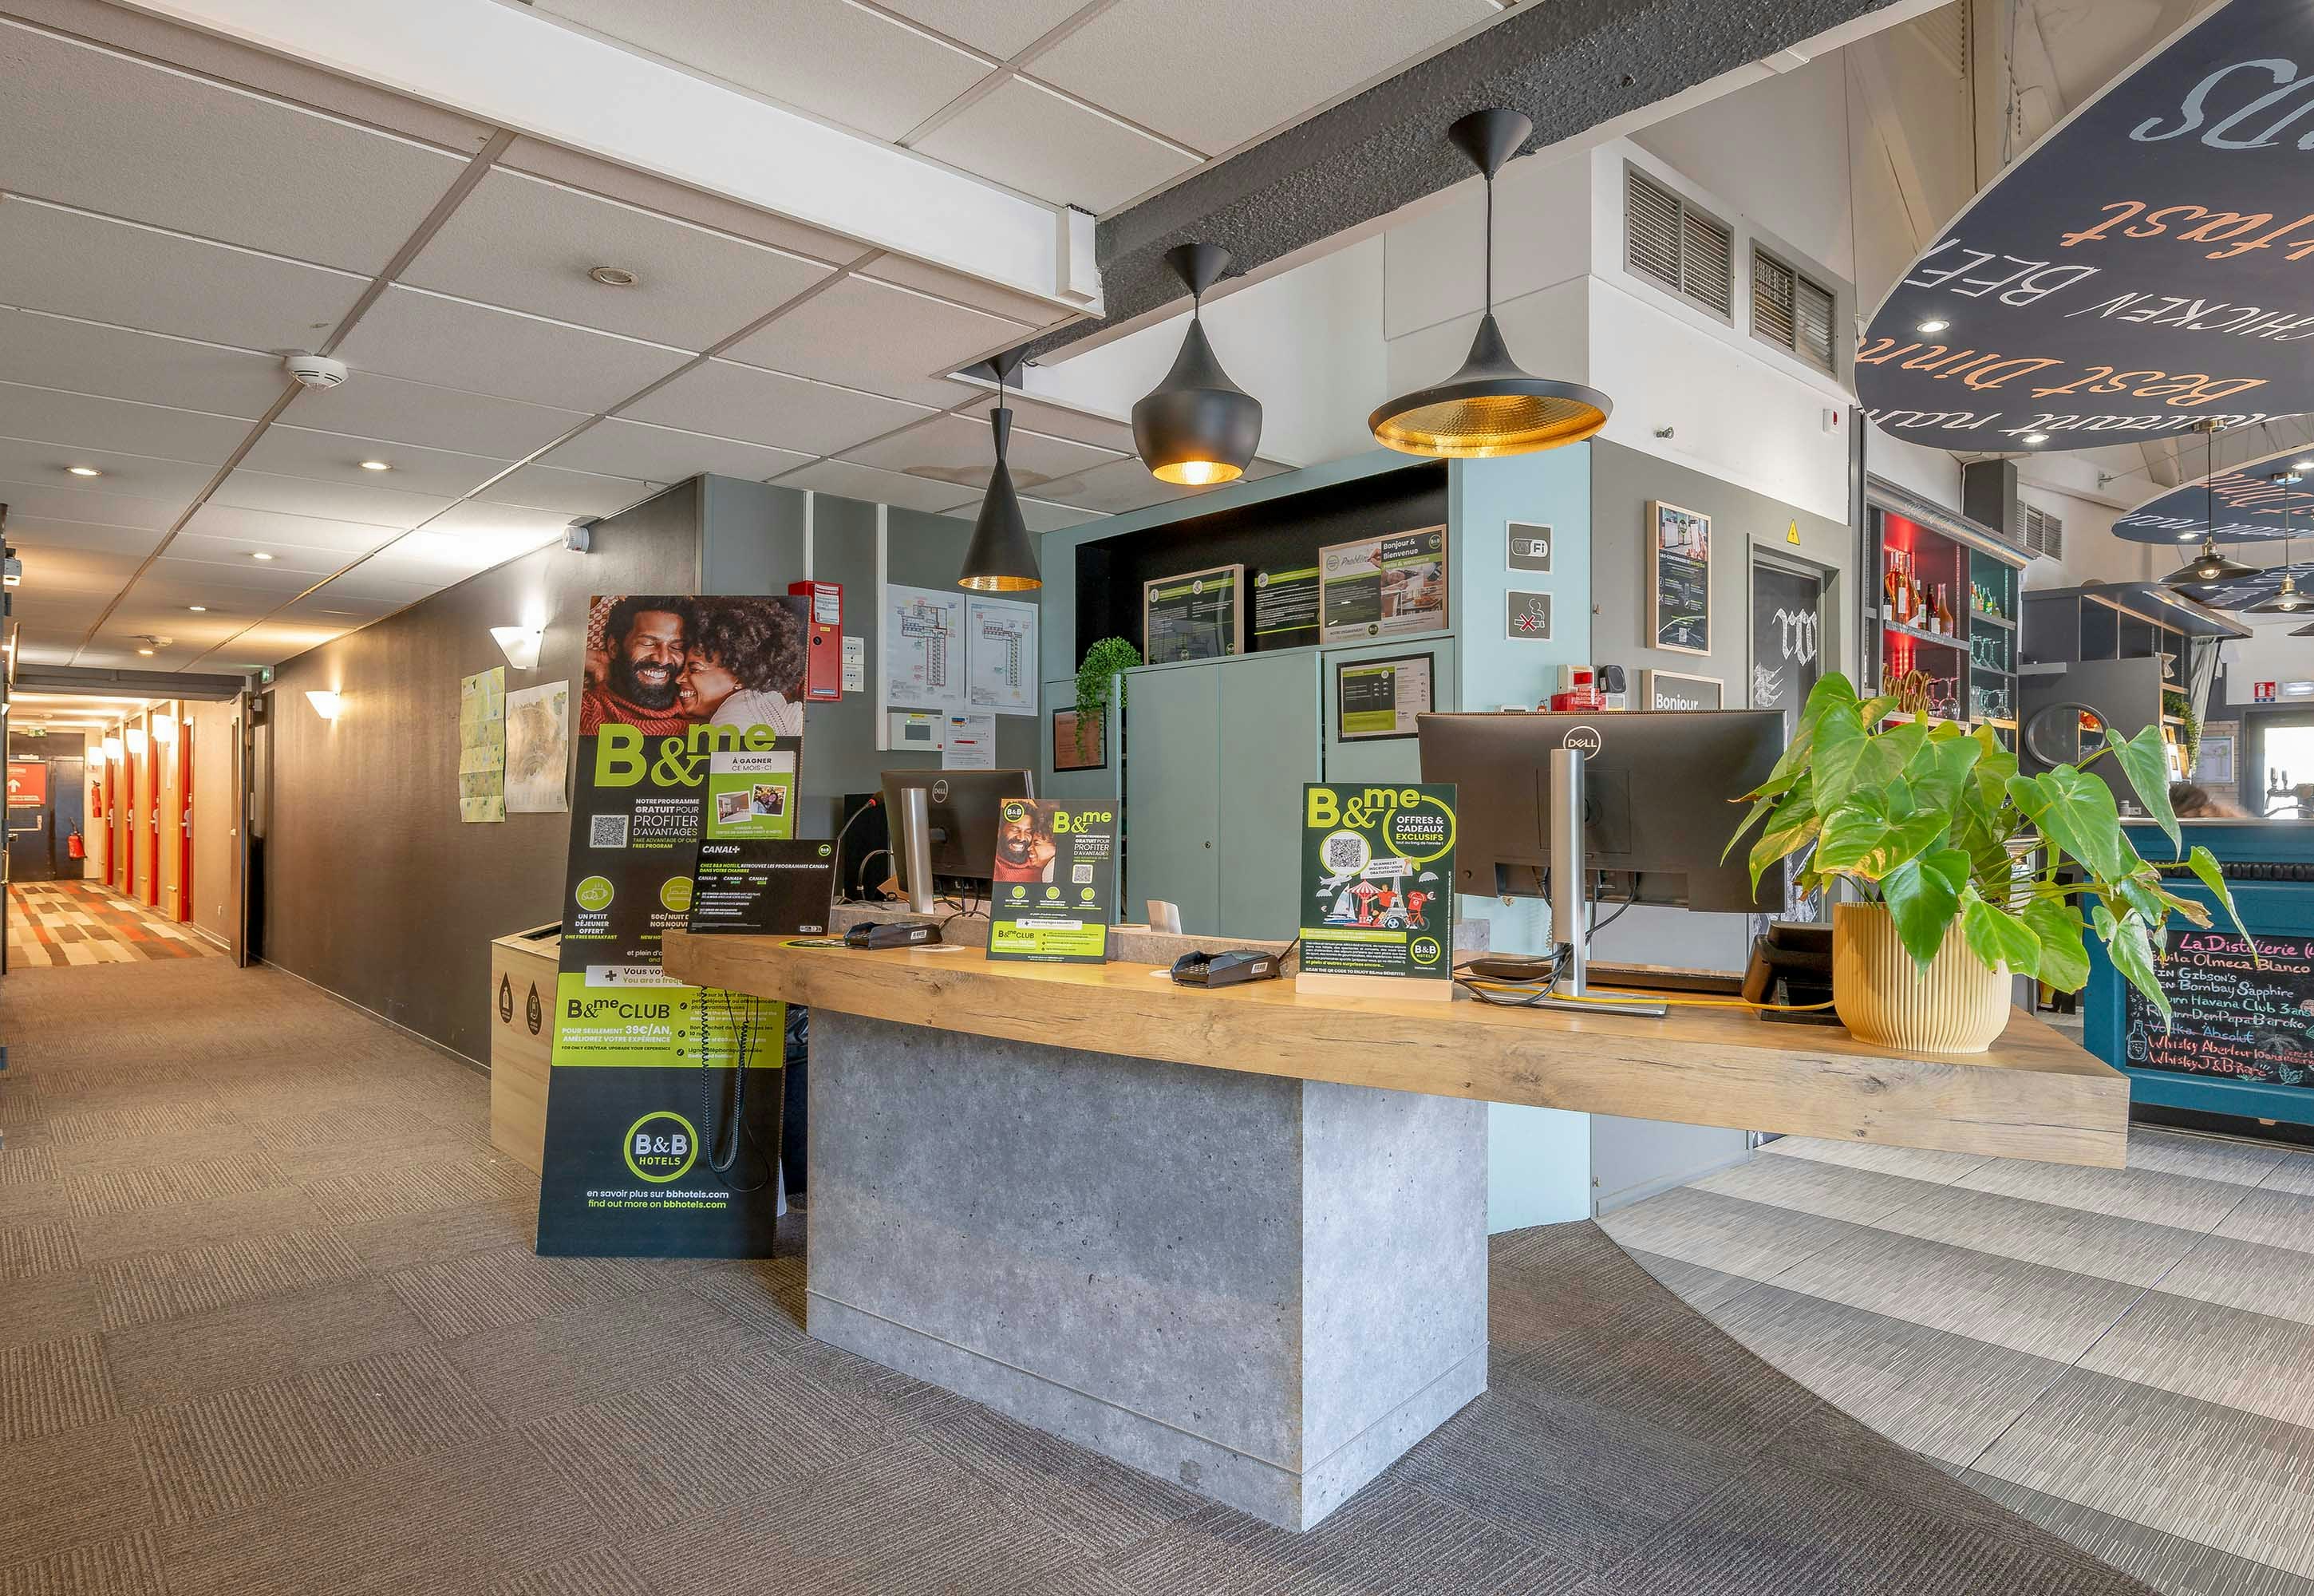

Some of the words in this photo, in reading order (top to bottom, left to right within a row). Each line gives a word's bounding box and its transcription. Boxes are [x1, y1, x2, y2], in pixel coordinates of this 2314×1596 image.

[2128, 57, 2314, 151] DS
[2059, 200, 2314, 262] fast
[1903, 238, 2102, 307] BEE
[1854, 337, 2065, 391] Dinn
[2031, 365, 2271, 407] Best
[1383, 540, 1409, 550] Bonjour
[1383, 548, 1419, 559] Bienvenue
[1656, 693, 1699, 710] Bonjour
[1568, 738, 1597, 748] DELL
[634, 815, 699, 827] PROFITER
[633, 828, 697, 836] D'AVANTAGES
[702, 845, 740, 854] CANAL+
[1415, 945, 1437, 954] B&B
[2180, 934, 2203, 950] La
[2194, 954, 2253, 970] Olmeca
[2257, 958, 2311, 974] Blanco
[2178, 979, 2235, 998] Bombay
[2237, 981, 2295, 1001] Sapphire
[619, 1003, 670, 1019] CLUB
[2191, 995, 2241, 1009] Havana
[2242, 998, 2276, 1013] Club
[2279, 1003, 2291, 1014] 3
[2147, 1035, 2198, 1055] Whisky
[2148, 1051, 2198, 1071] Whisky
[635, 1133, 688, 1156] B&B
[600, 1189, 627, 1198] savoir
[629, 1189, 649, 1199] plus
[666, 1190, 729, 1199] bbhotels.com
[663, 1200, 727, 1209] bbhotels.com
